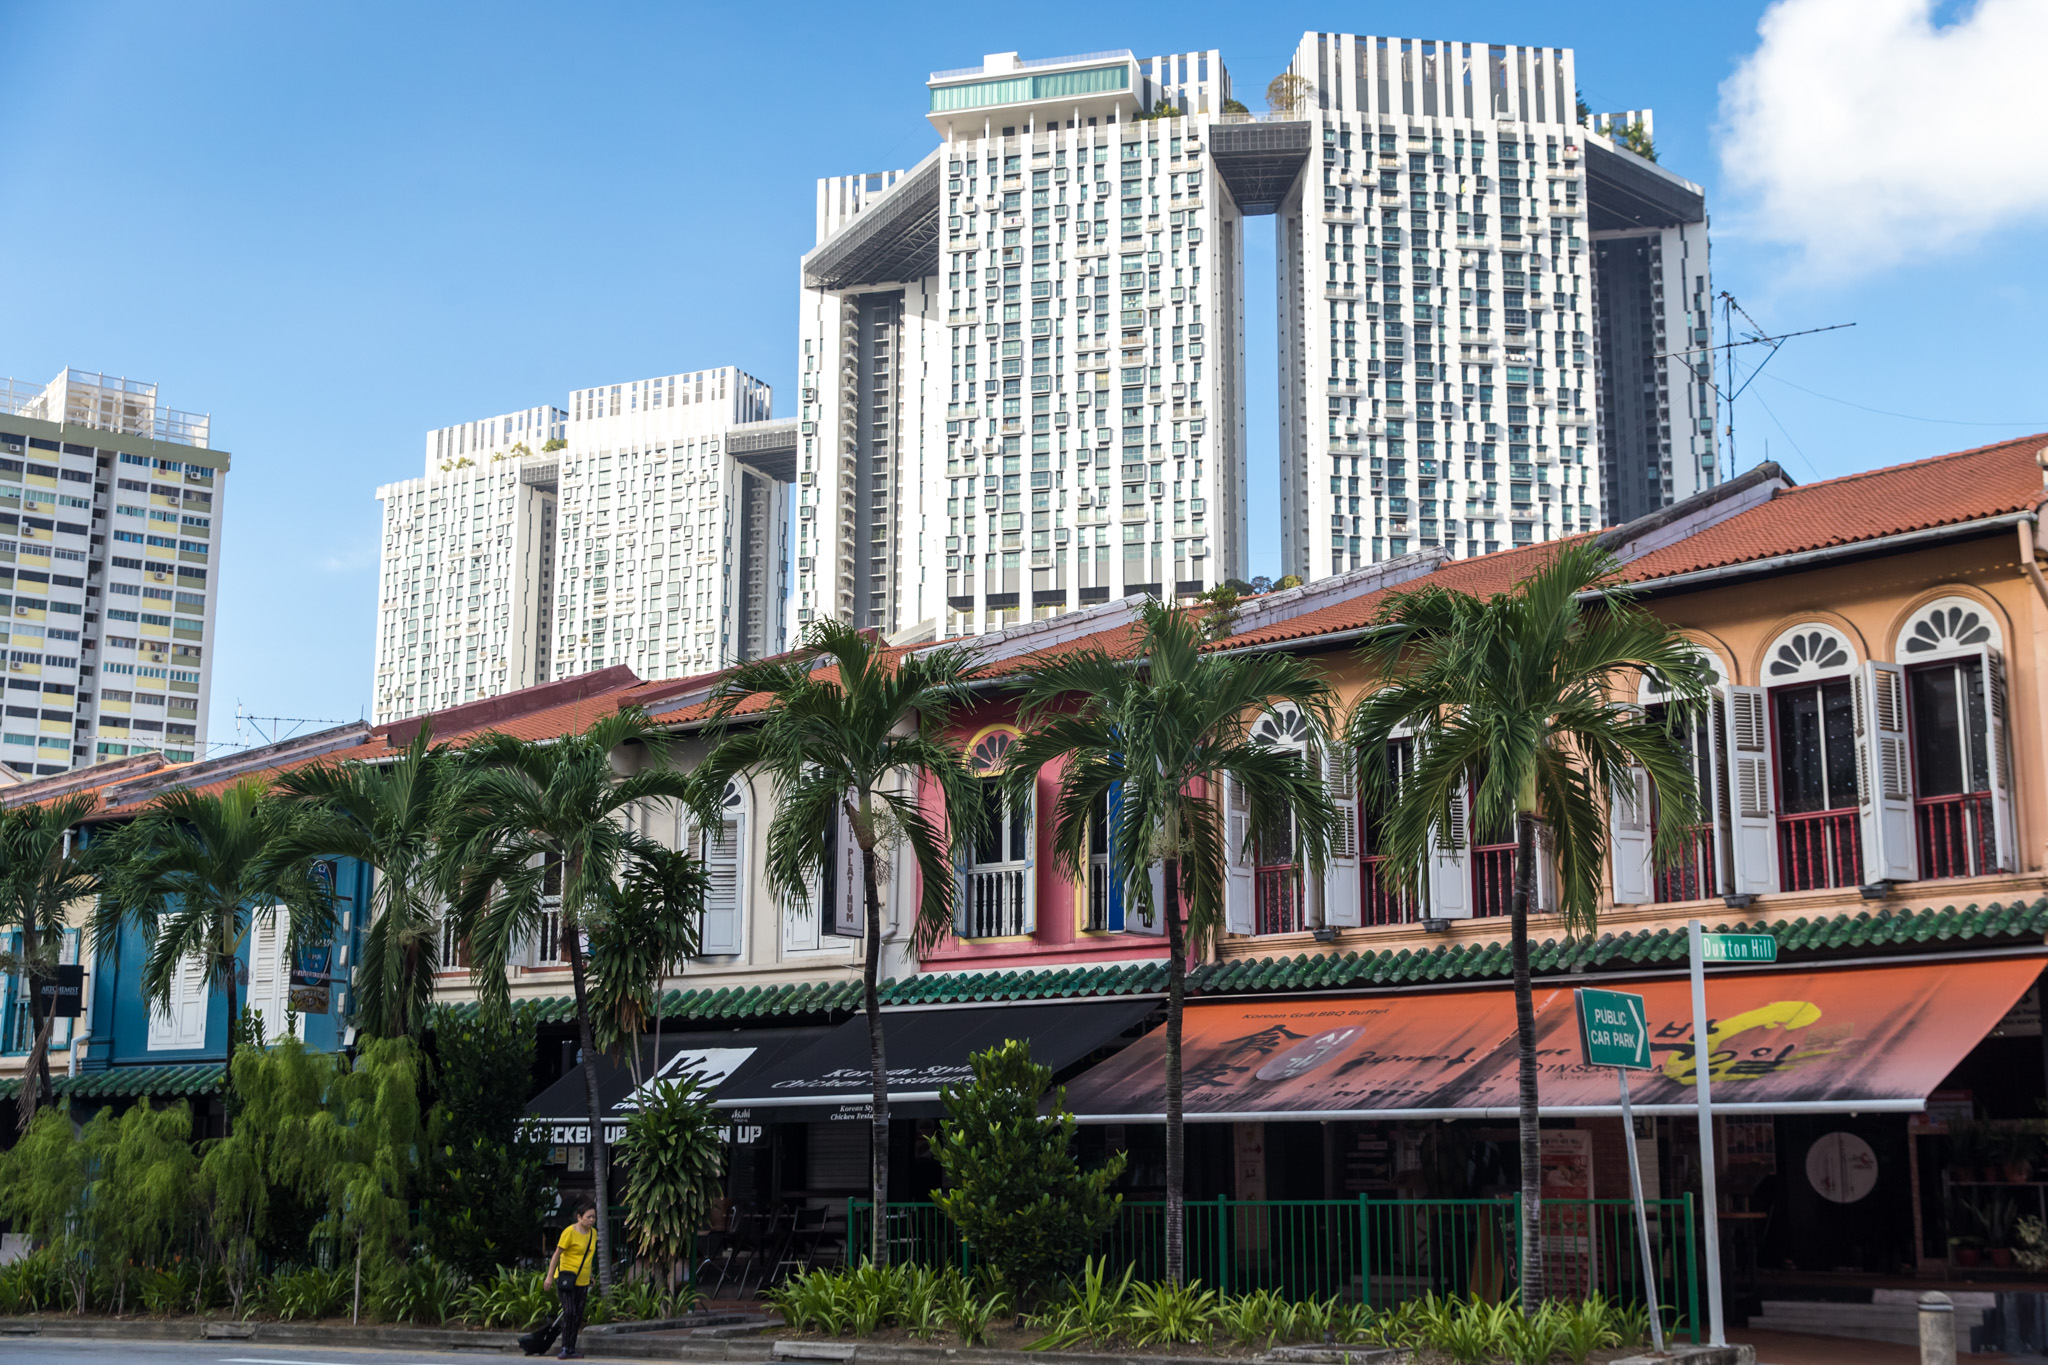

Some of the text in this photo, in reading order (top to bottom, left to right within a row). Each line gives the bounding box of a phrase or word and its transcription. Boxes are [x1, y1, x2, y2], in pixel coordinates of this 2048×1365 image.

[846, 848, 854, 923] PLATINUM
[1703, 937, 1772, 958] Duxton Hill
[1290, 1011, 1317, 1019] Grill
[1348, 1008, 1390, 1016] Buffet
[1594, 1008, 1627, 1026] PUBLIC
[1590, 1029, 1636, 1049] CAR PARK
[822, 1068, 917, 1078] Koran
[771, 1079, 866, 1089] Chicken
[840, 1104, 864, 1113] Korean
[830, 1112, 892, 1121] Chicken Restat
[738, 1126, 762, 1144] UP
